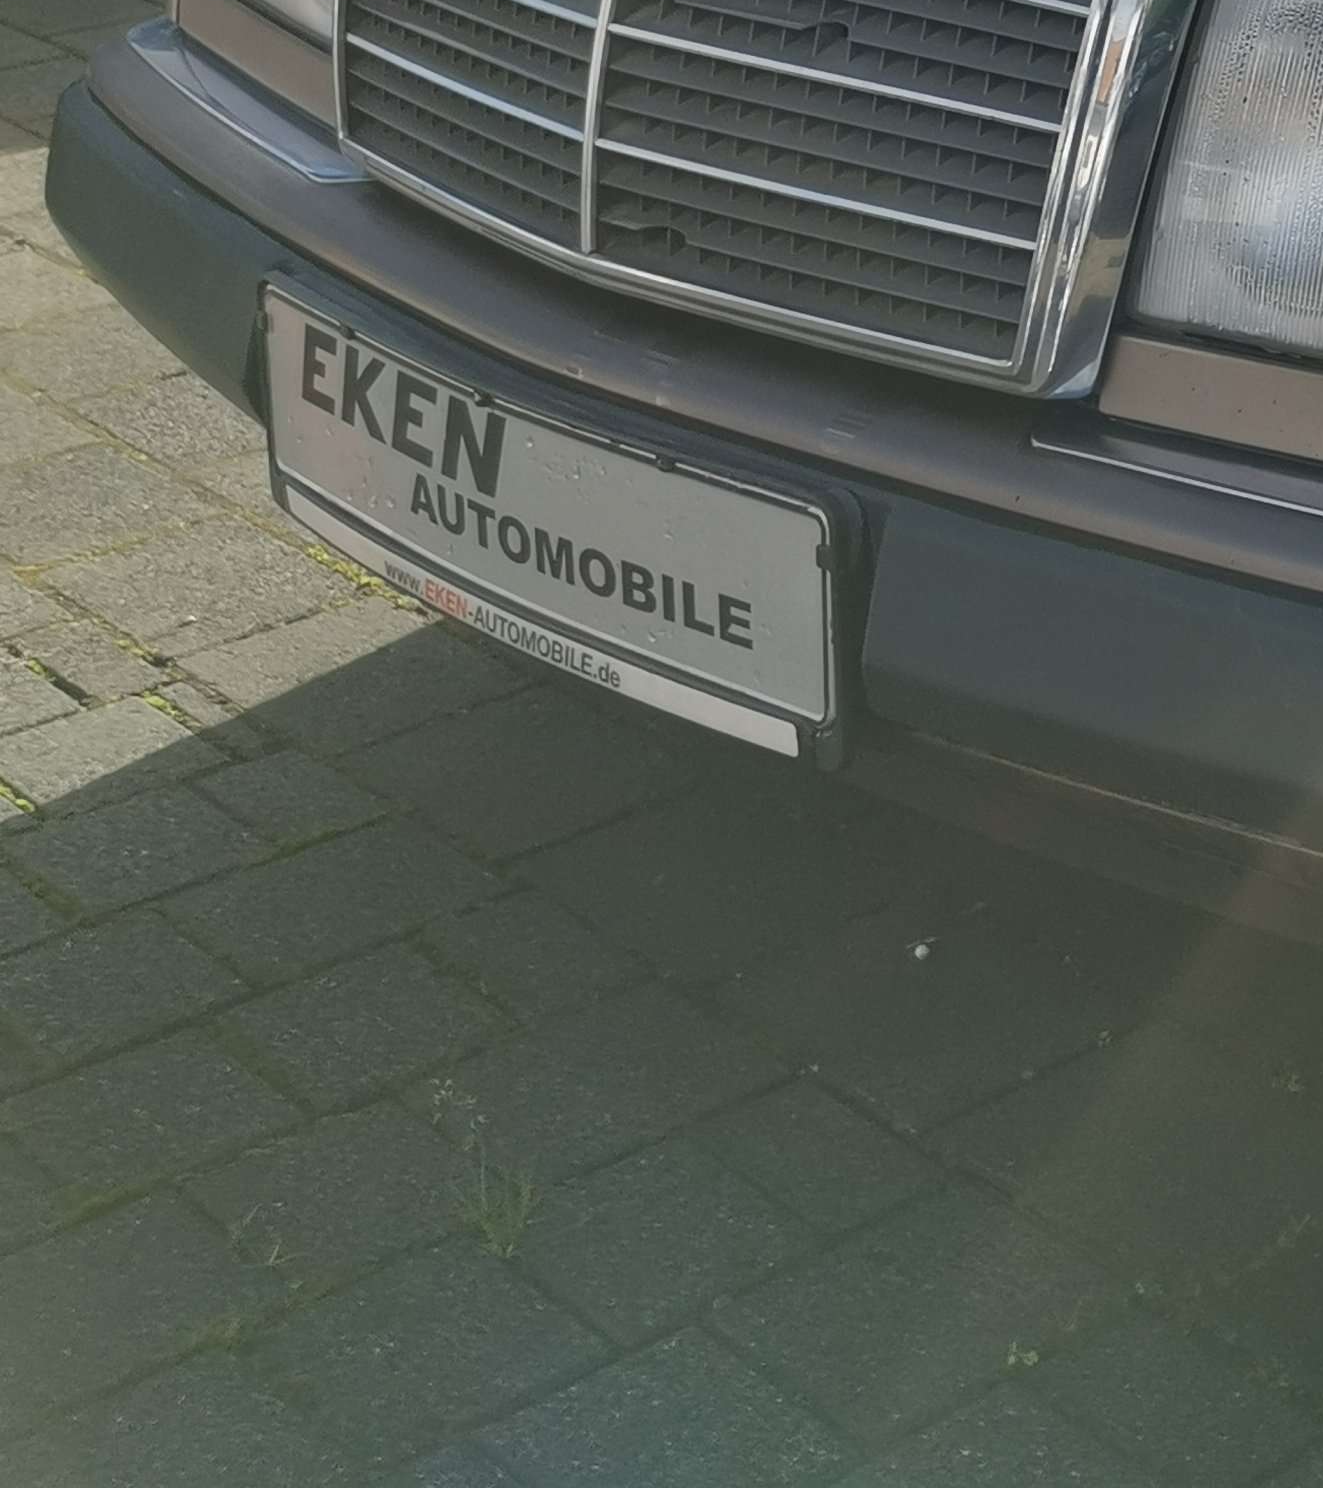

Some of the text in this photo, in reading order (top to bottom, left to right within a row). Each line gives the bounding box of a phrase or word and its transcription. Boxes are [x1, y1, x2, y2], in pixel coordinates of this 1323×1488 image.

[301, 322, 508, 498] EKEN
[383, 559, 621, 689] www.EKEN-AUTOMOBILE.de
[409, 473, 754, 651] AUTOMOBILE
